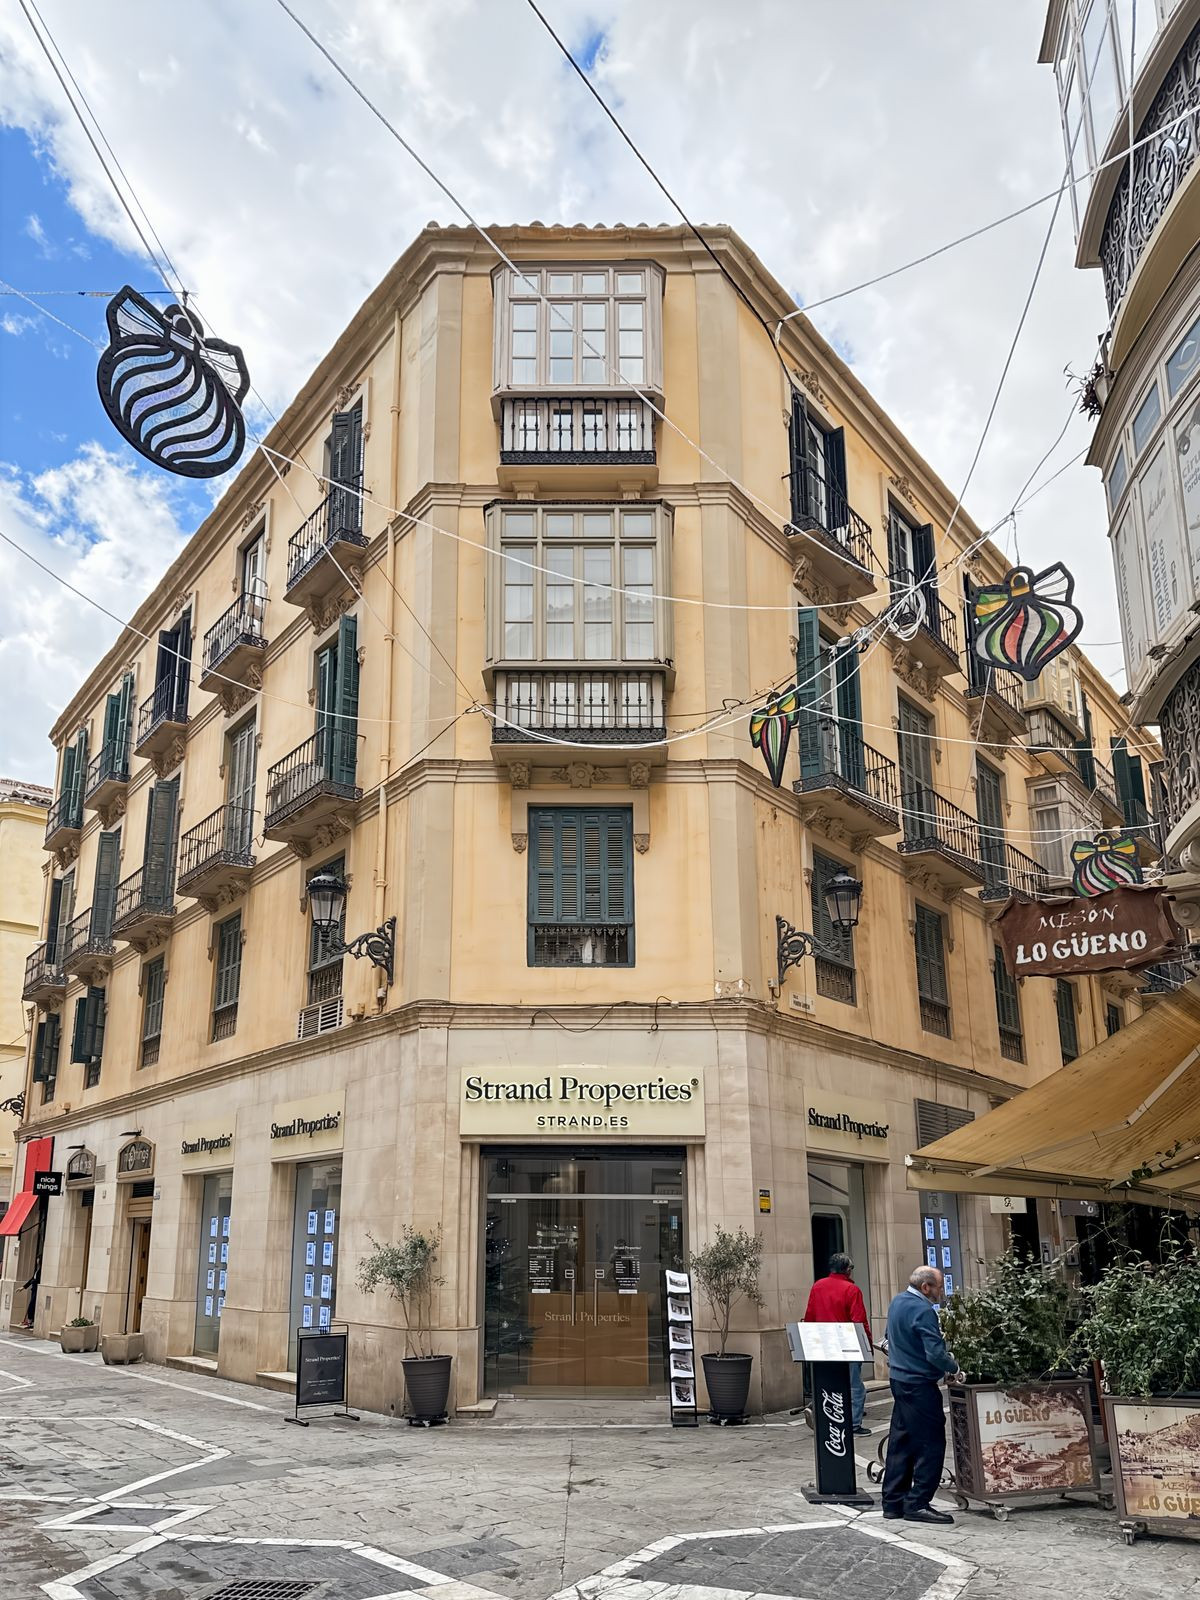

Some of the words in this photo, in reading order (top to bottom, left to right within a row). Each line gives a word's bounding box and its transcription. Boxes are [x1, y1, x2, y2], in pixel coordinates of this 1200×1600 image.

[1151, 541, 1165, 634] implantes
[1038, 902, 1119, 932] MESÓN
[1016, 942, 1047, 964] LO
[1052, 929, 1147, 959] GÜENO
[465, 1076, 552, 1101] Strand
[537, 1116, 629, 1127] STRAND.ES
[808, 1107, 840, 1130] Strand
[270, 1119, 296, 1139] Strand
[181, 1138, 200, 1154] Strand
[36, 1183, 59, 1191] things
[985, 1410, 1002, 1425] LO
[1137, 1495, 1160, 1511] LO
